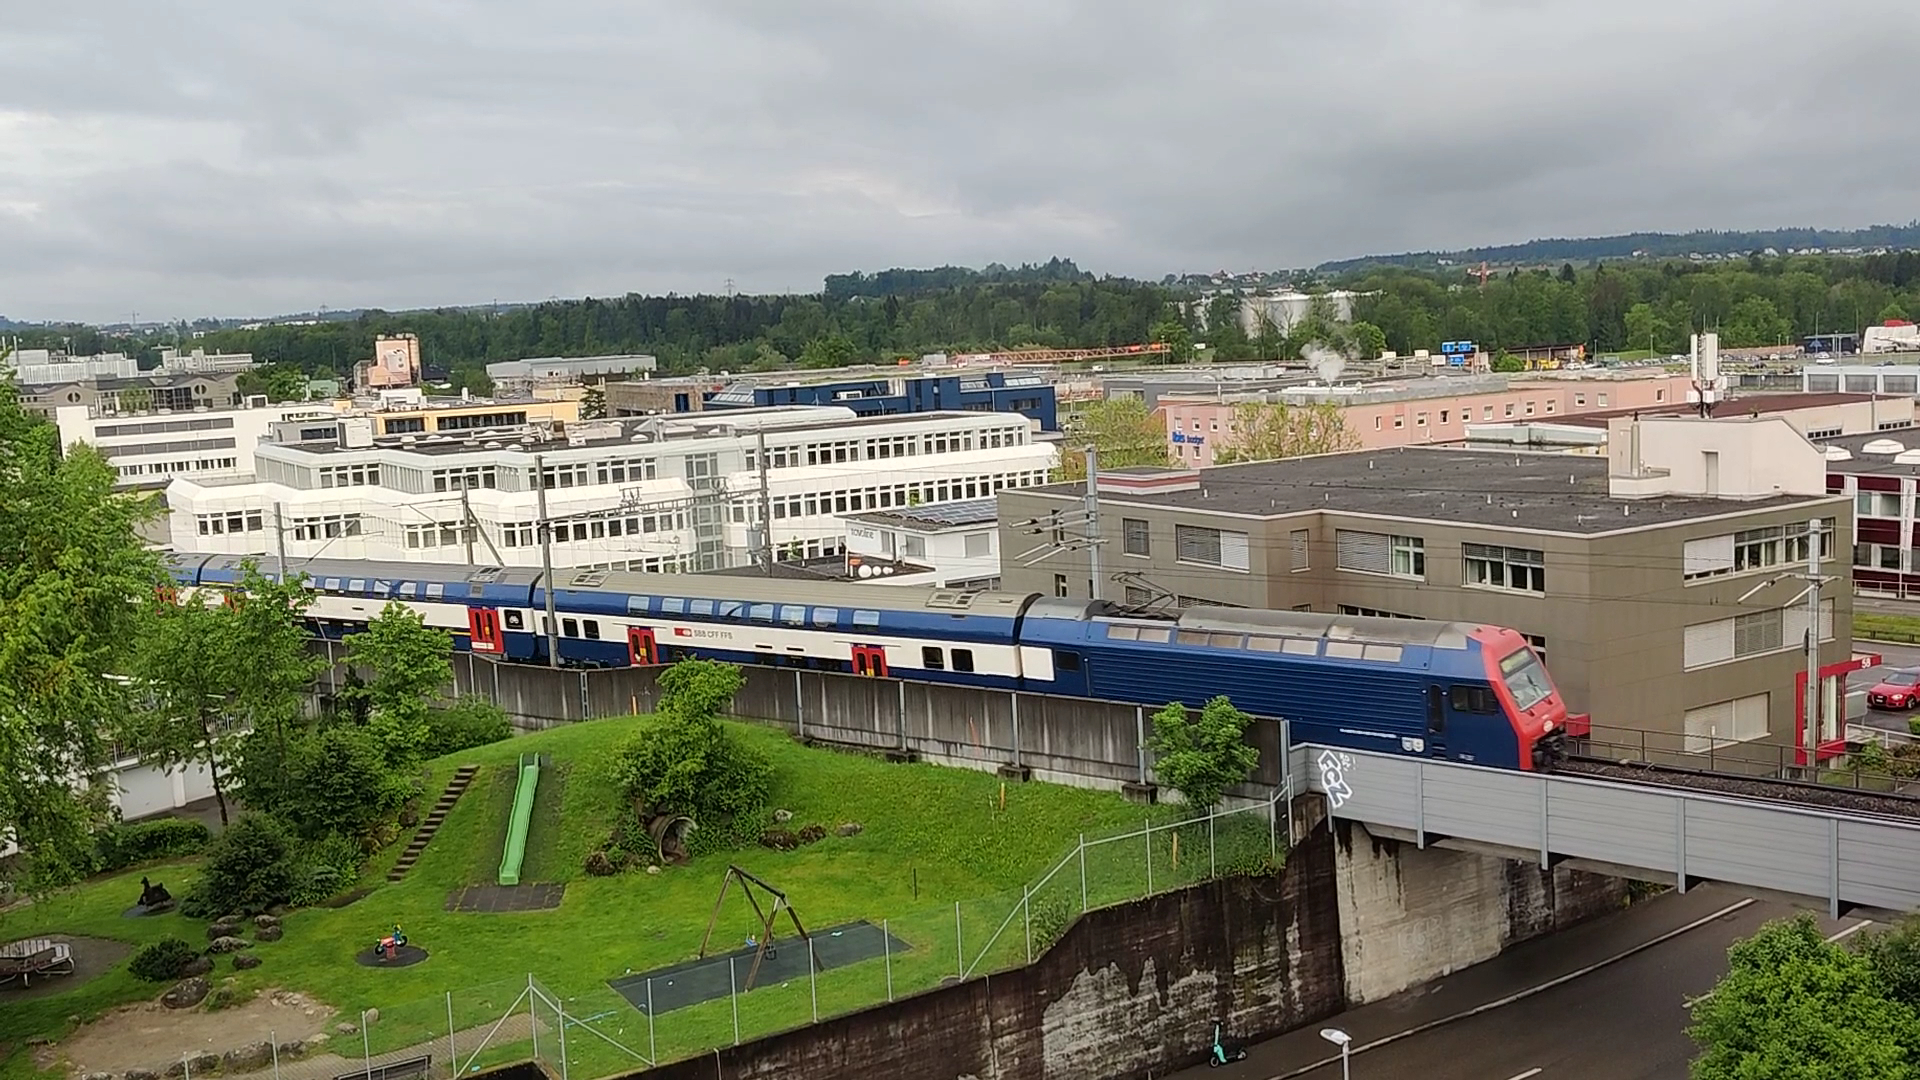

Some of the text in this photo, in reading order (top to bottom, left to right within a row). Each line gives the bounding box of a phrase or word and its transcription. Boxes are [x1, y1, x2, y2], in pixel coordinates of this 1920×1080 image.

[1187, 435, 1205, 445] budget
[694, 630, 707, 638] SBB
[720, 632, 733, 640] FFS
[1861, 657, 1871, 669] 58
